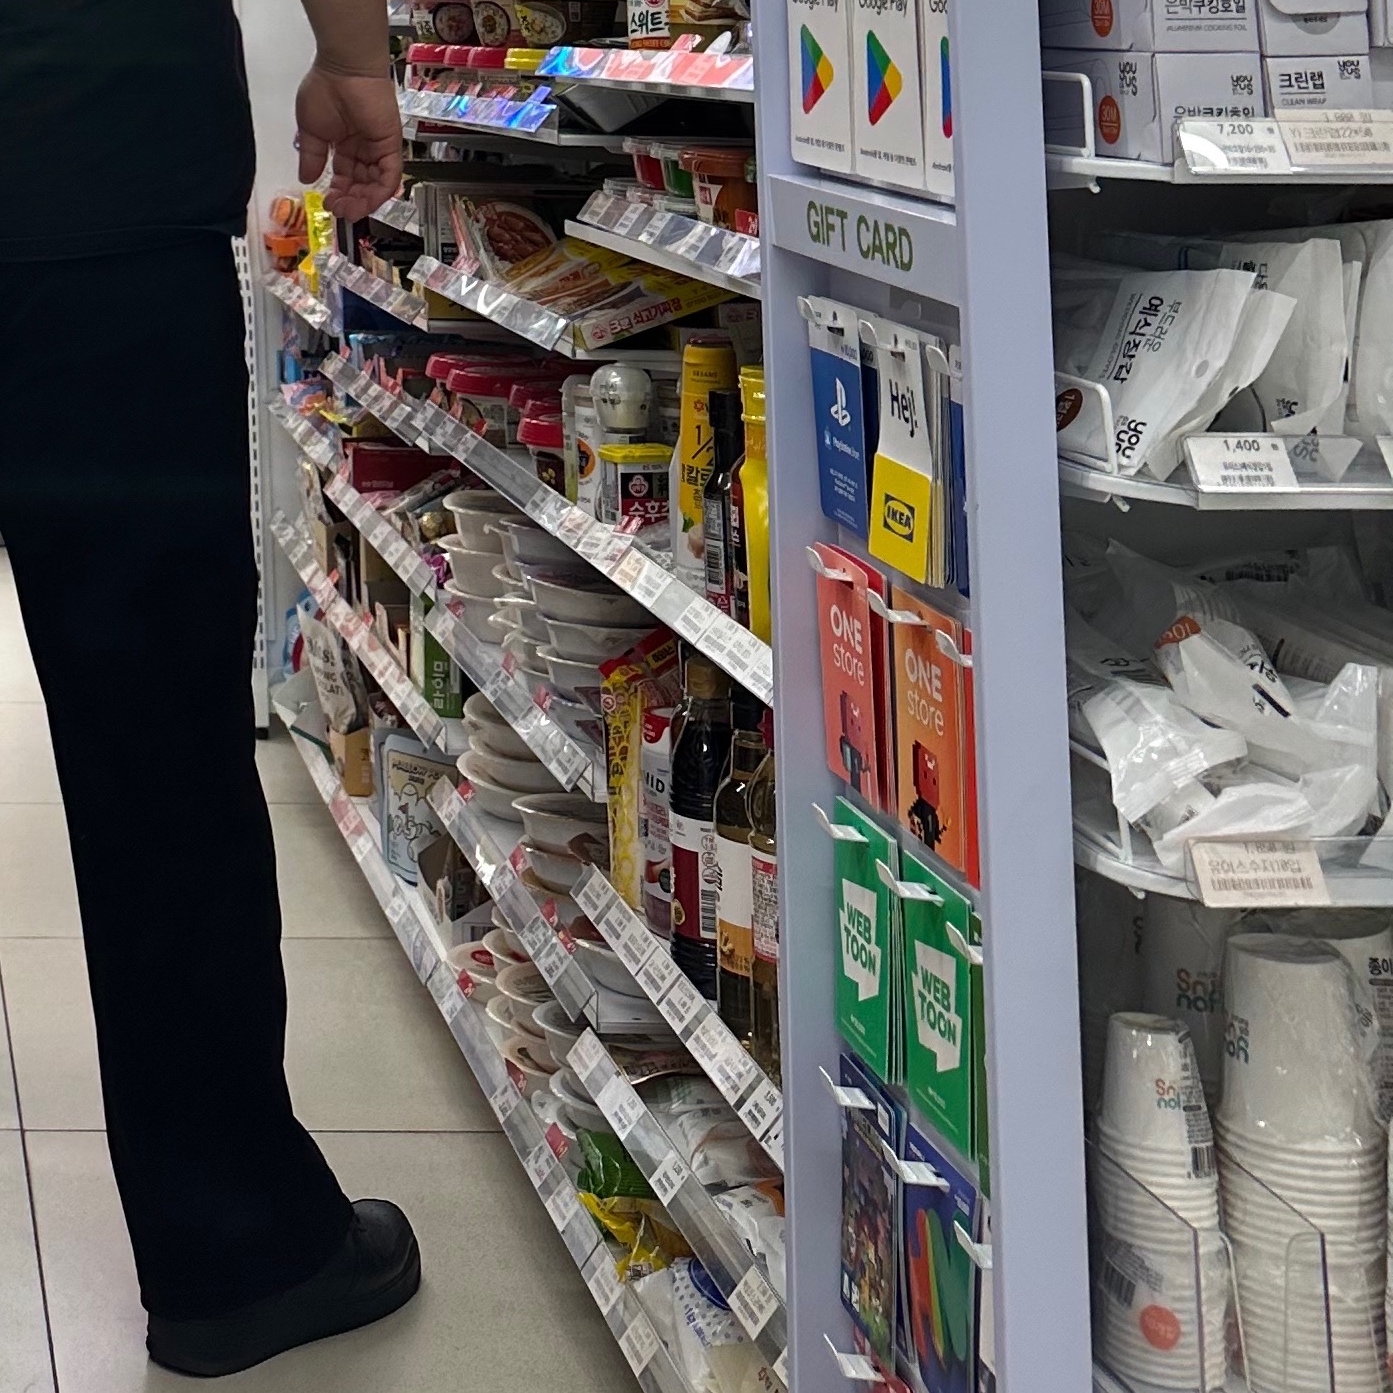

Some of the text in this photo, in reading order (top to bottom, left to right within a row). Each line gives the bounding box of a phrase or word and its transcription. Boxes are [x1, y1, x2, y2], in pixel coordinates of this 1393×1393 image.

[630, 9, 667, 35] 스위트
[1279, 70, 1325, 91] 크린랩
[1216, 122, 1254, 137] 7,200
[807, 200, 914, 273] GIFT CARD
[886, 378, 923, 439] Hej!
[1223, 438, 1261, 454] 1,400
[886, 503, 914, 535] IKEA
[830, 604, 864, 655] ONE
[832, 643, 866, 686] store
[905, 649, 943, 702] ONE
[907, 692, 945, 737] store
[846, 901, 873, 941] WEB
[842, 930, 877, 981] TOON
[920, 963, 952, 1010] WEB
[916, 992, 959, 1049] TOON
